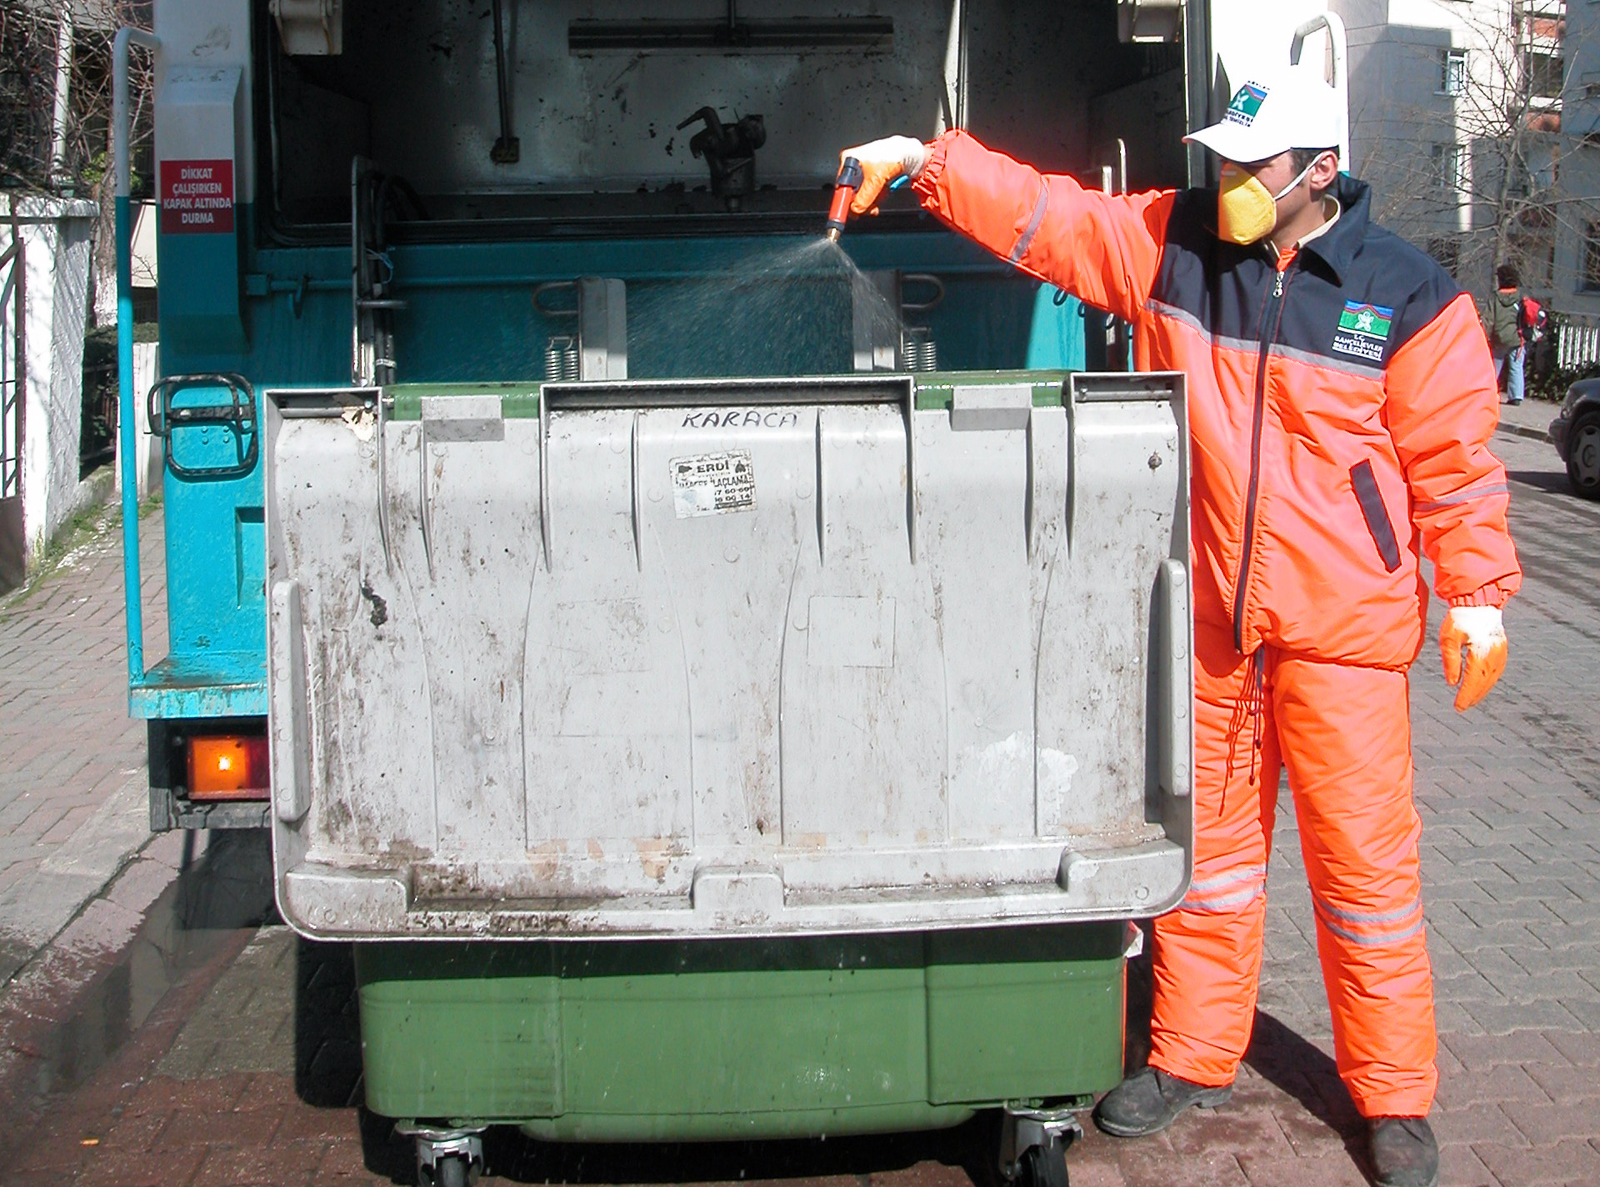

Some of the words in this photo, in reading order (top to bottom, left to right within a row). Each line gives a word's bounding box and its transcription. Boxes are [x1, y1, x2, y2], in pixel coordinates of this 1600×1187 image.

[181, 165, 213, 180] DİKKAT
[172, 183, 222, 197] ÇALIŞIRKEN
[163, 198, 193, 209] KAPAK
[194, 197, 232, 209] ALTINDA
[181, 212, 214, 224] DURMA
